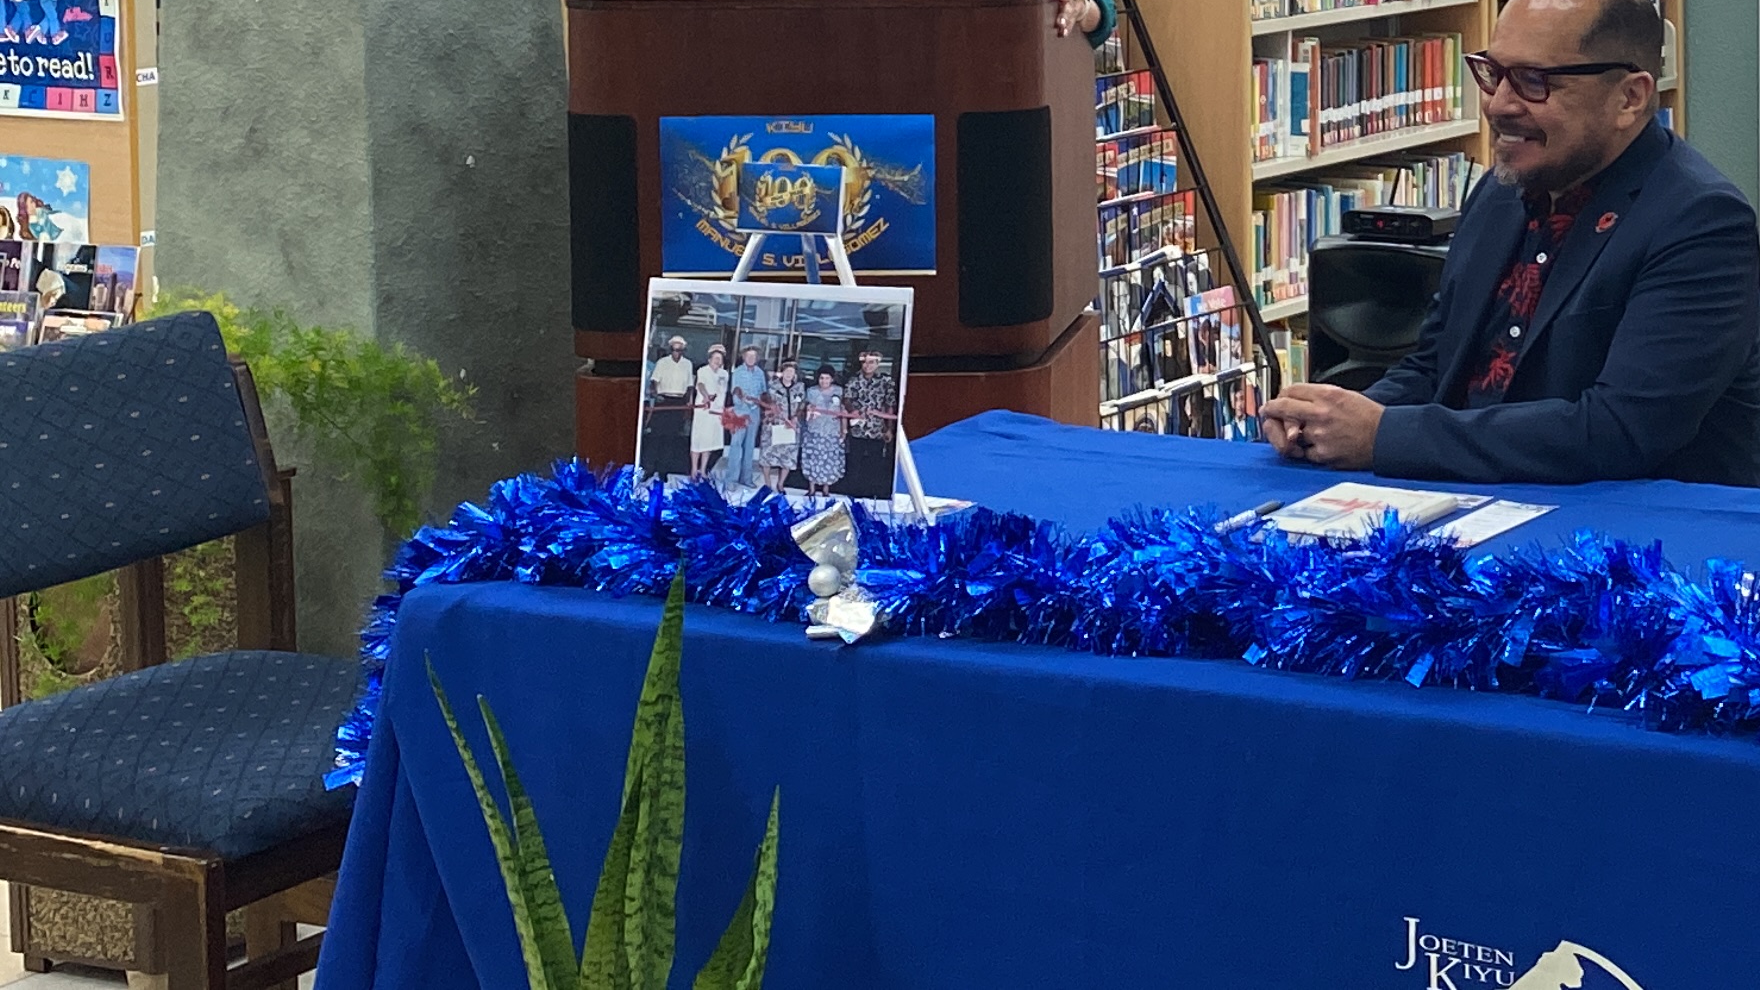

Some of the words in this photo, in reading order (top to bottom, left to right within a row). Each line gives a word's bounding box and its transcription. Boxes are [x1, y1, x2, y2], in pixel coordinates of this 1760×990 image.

[7, 48, 34, 76] to
[37, 52, 95, 80] read!
[136, 71, 156, 82] CHA
[103, 93, 112, 107] Z
[695, 218, 746, 256] MANUE
[1395, 916, 1515, 970] JOETEN
[1424, 952, 1515, 990] KIYU
